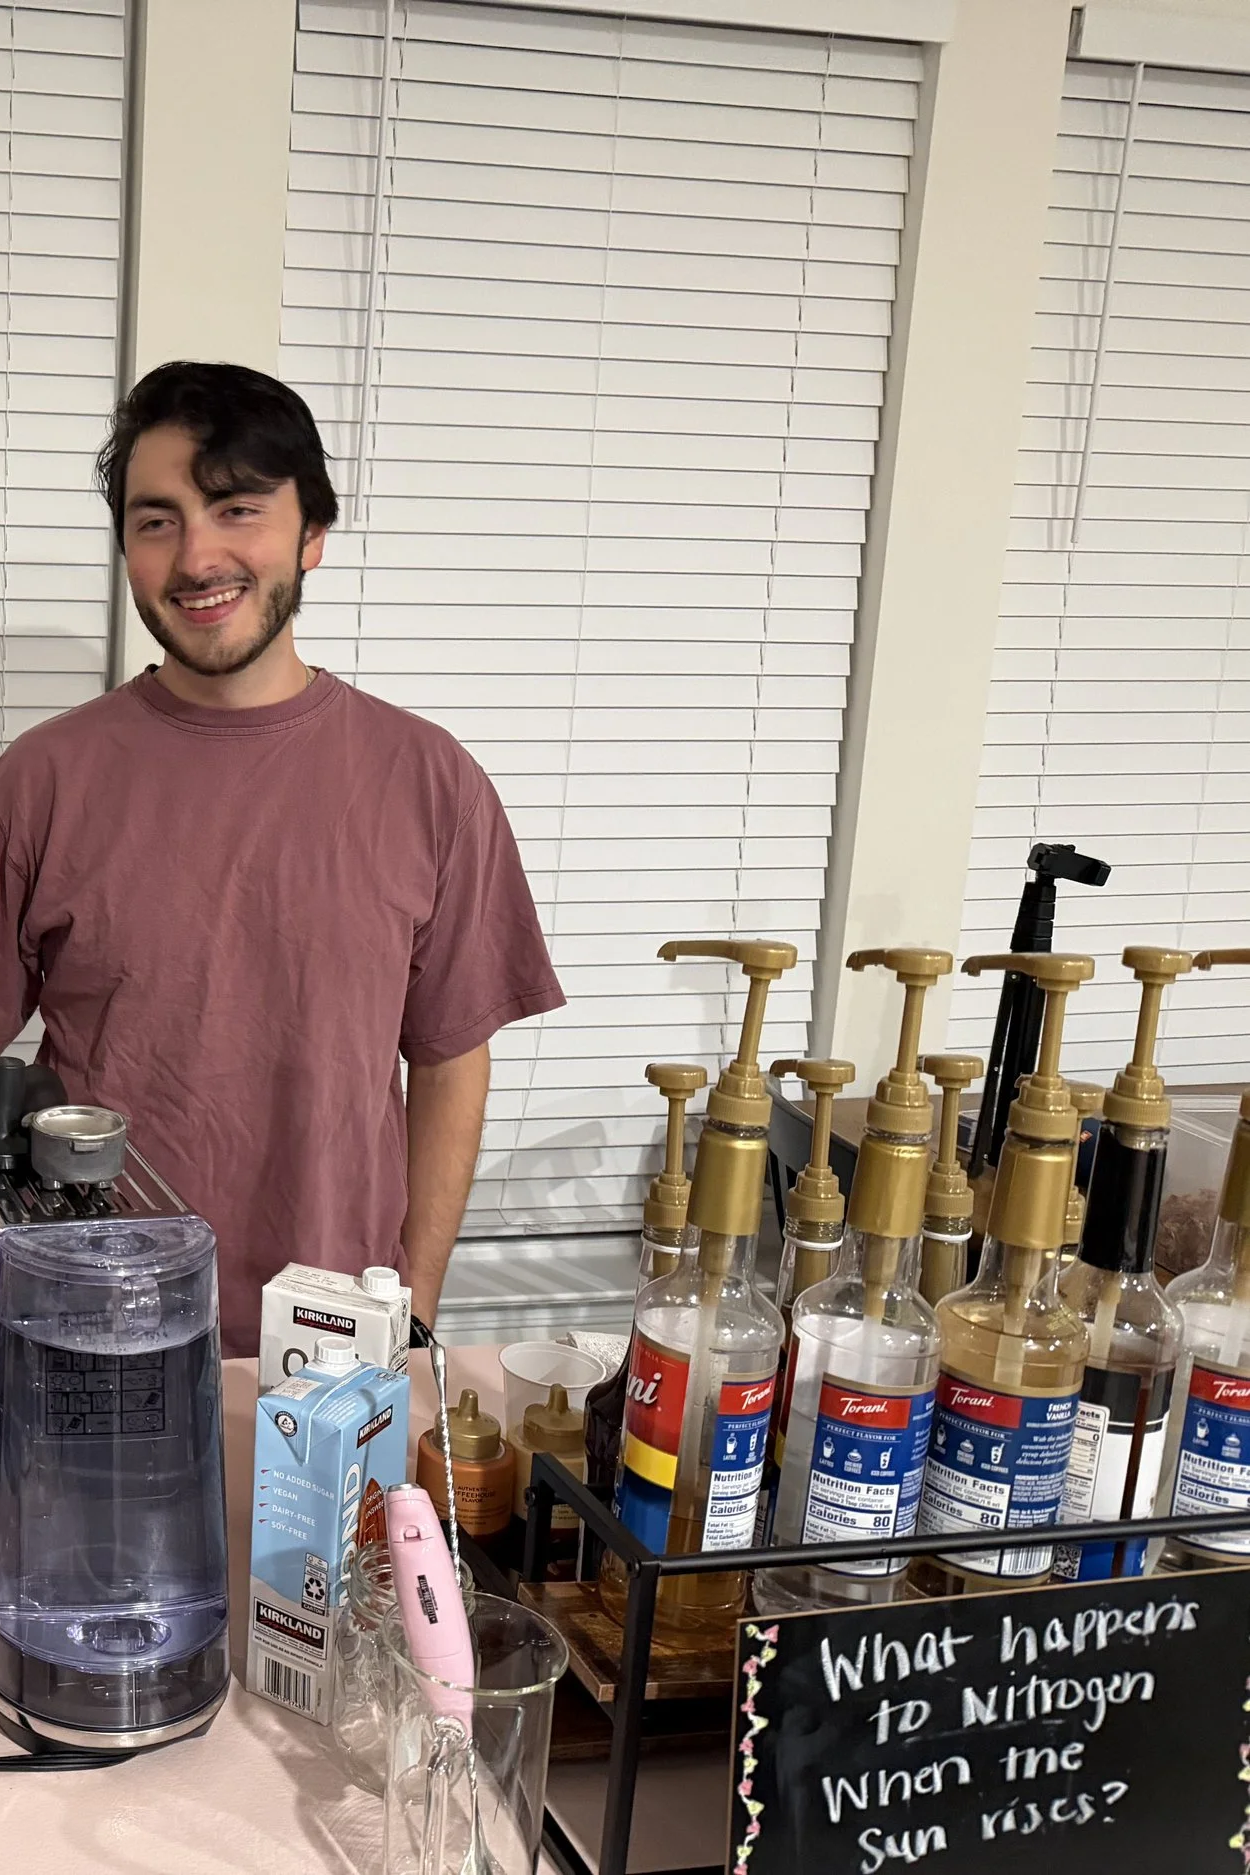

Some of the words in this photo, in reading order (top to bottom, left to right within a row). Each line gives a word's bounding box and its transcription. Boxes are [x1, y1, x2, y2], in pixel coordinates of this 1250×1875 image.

[296, 1308, 354, 1329] KIRKLAND
[741, 1382, 773, 1410] Torani
[951, 1387, 993, 1407] Torani
[1213, 1380, 1250, 1400] Tora
[840, 1397, 885, 1416] Torani
[1046, 1411, 1072, 1421] VANILLA
[1049, 1402, 1073, 1413] FRENCH
[1078, 1408, 1101, 1419] acts
[359, 1408, 392, 1440] KIRKLAND
[826, 1424, 855, 1438] PERFECT
[856, 1431, 882, 1441] FLAVOR
[883, 1434, 897, 1442] FOR
[940, 1413, 963, 1427] PERFECT
[963, 1422, 991, 1437] FLAVOR
[1093, 1433, 1100, 1442] 0
[1183, 1453, 1235, 1474] Nutrition
[274, 1470, 285, 1480] NO
[286, 1474, 311, 1489] ADDED
[312, 1484, 335, 1501] SUGAR
[714, 1472, 753, 1482] Nutrition
[812, 1472, 862, 1493] Nutrition
[866, 1486, 895, 1496] Facts
[928, 1461, 968, 1485] Nutrition
[972, 1480, 1005, 1495] Facts
[273, 1487, 298, 1502] VEGAN
[365, 1488, 385, 1505] ORIGIN
[811, 1489, 829, 1500] Serving
[820, 1486, 846, 1499] servings
[964, 1487, 993, 1500] container
[1180, 1484, 1230, 1504] Calories
[272, 1504, 316, 1527] DAIRY-FREE
[365, 1500, 385, 1520] UNSWEE
[711, 1503, 748, 1514] Calories
[810, 1504, 857, 1525] Calories
[873, 1516, 891, 1528] 80
[923, 1490, 963, 1517] Calories
[980, 1513, 1000, 1526] 80
[271, 1521, 308, 1540] SOY-FREE
[807, 1520, 819, 1529] Total
[820, 1525, 829, 1533] Fat
[303, 1604, 324, 1615] CARTON
[260, 1605, 322, 1640] KIRKLAND
[820, 1626, 974, 1702] What
[999, 1601, 1200, 1665] happens
[304, 1658, 324, 1669] FORMULA
[867, 1698, 932, 1745] to
[961, 1670, 1156, 1733] Nitrogen
[821, 1754, 971, 1824] When
[998, 1741, 1086, 1782] the
[857, 1824, 948, 1875] Sun
[981, 1780, 1129, 1840] rises?
